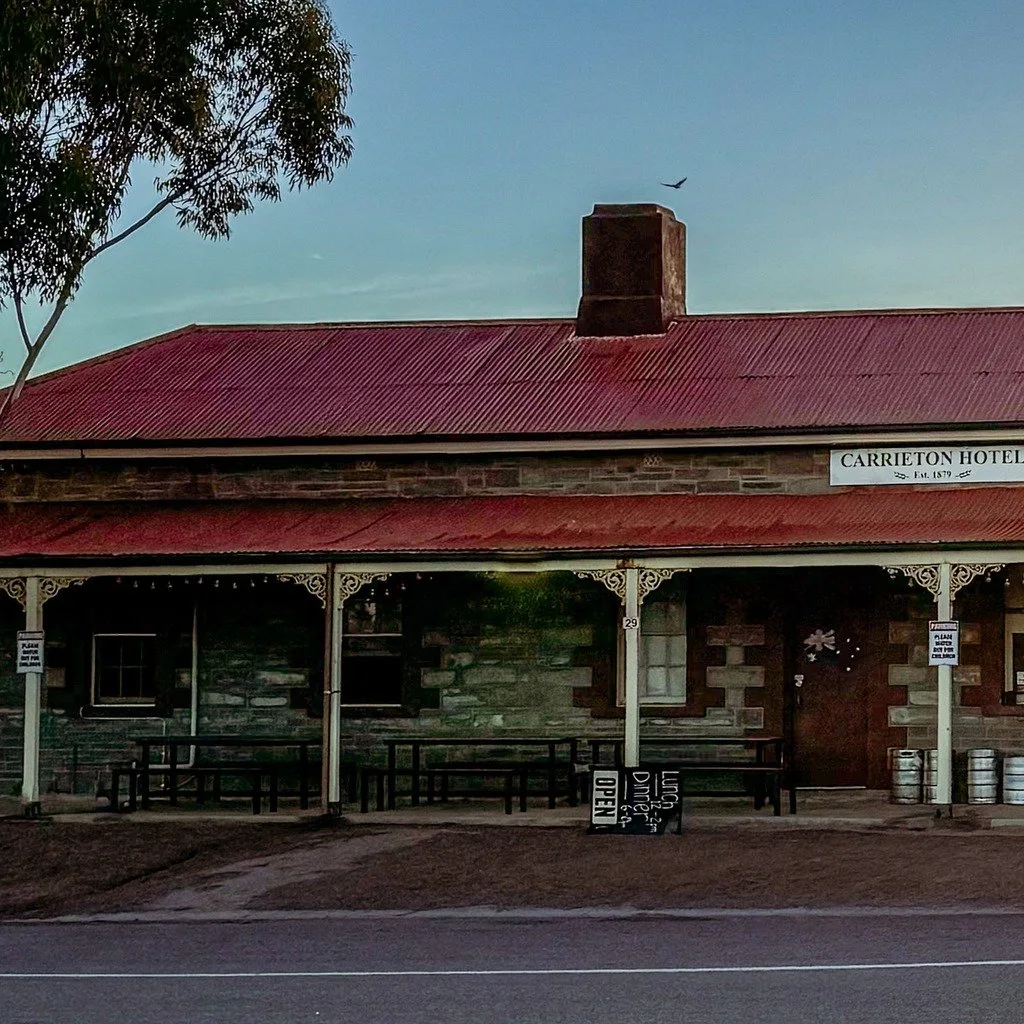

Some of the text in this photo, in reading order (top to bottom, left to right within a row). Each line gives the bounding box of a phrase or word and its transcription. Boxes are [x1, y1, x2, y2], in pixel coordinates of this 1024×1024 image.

[840, 450, 953, 468] CARRIETON
[933, 470, 952, 479] 1879
[625, 618, 638, 628] 29
[594, 777, 617, 818] OPEN
[633, 771, 650, 822] Dinner
[661, 771, 680, 810] Lunch
